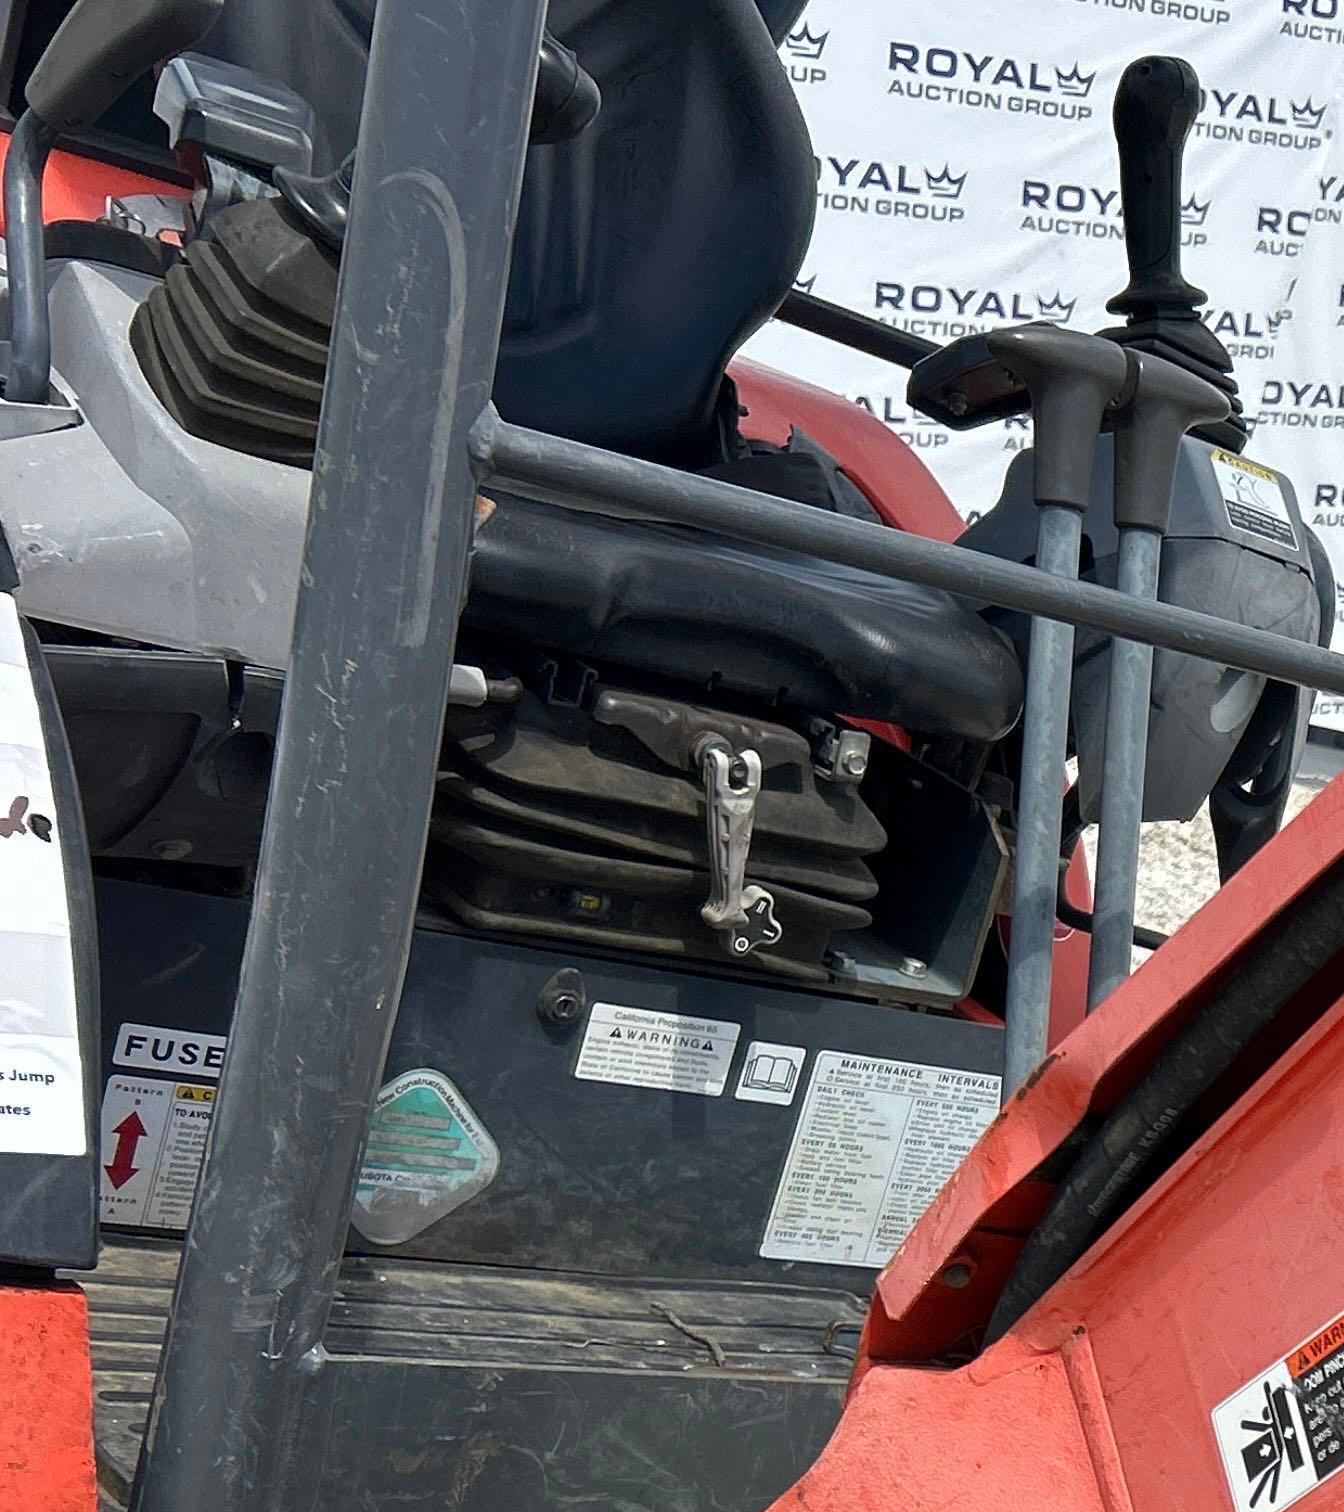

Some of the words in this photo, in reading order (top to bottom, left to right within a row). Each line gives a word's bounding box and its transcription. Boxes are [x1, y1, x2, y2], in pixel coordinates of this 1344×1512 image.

[888, 41, 1052, 92] ROYAL
[887, 79, 1002, 110] AUCTION
[1007, 96, 1093, 121] GROUP
[1211, 89, 1288, 125] YAL
[1194, 122, 1243, 141] TION
[1248, 128, 1322, 150] GROUP
[827, 156, 921, 195] YAL
[875, 199, 965, 221] GROUP
[1021, 179, 1120, 216] ROY
[874, 280, 1035, 321] ROYAL
[124, 1034, 225, 1068] FUSE
[626, 1029, 700, 1049] WARNING
[8, 1068, 55, 1086] Jump
[840, 1059, 924, 1080] MAINTENANCE
[937, 1073, 1000, 1091] INTERVALS
